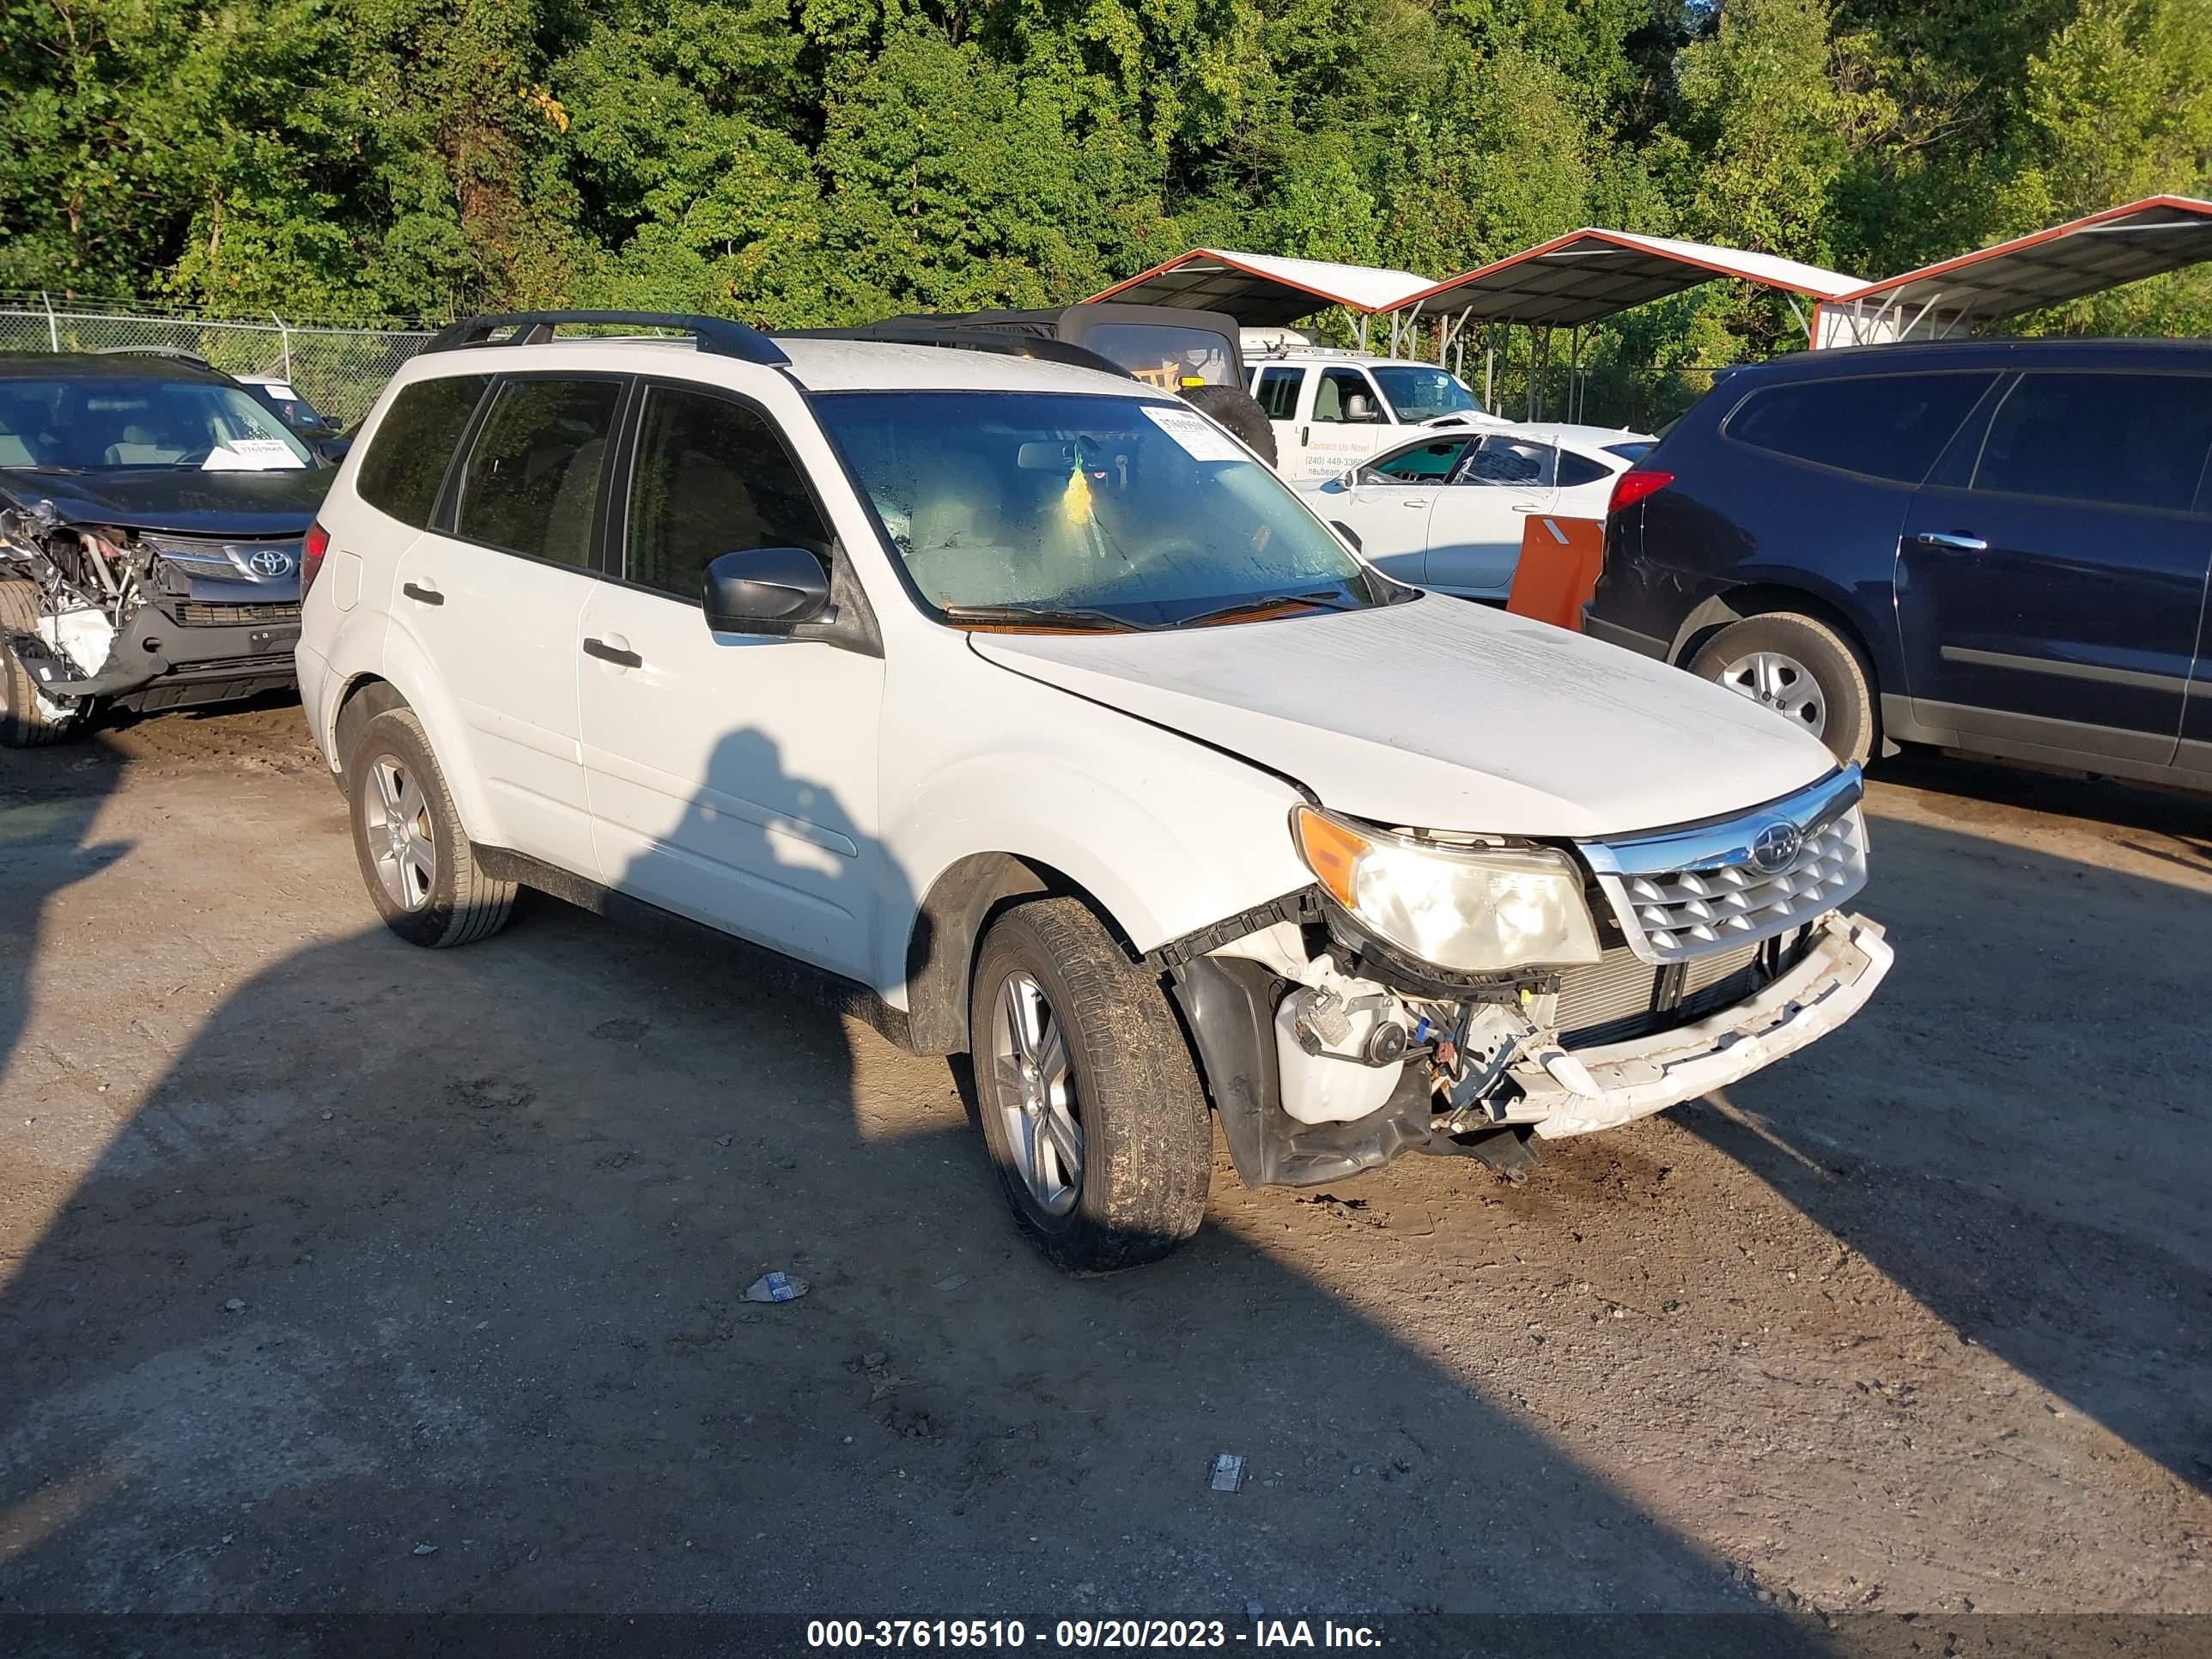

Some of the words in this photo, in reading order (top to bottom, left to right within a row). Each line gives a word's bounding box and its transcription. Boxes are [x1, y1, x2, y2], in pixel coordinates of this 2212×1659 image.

[1309, 441, 1334, 452] Contact
[1339, 442, 1349, 452] Us
[1304, 456, 1325, 466] (240)
